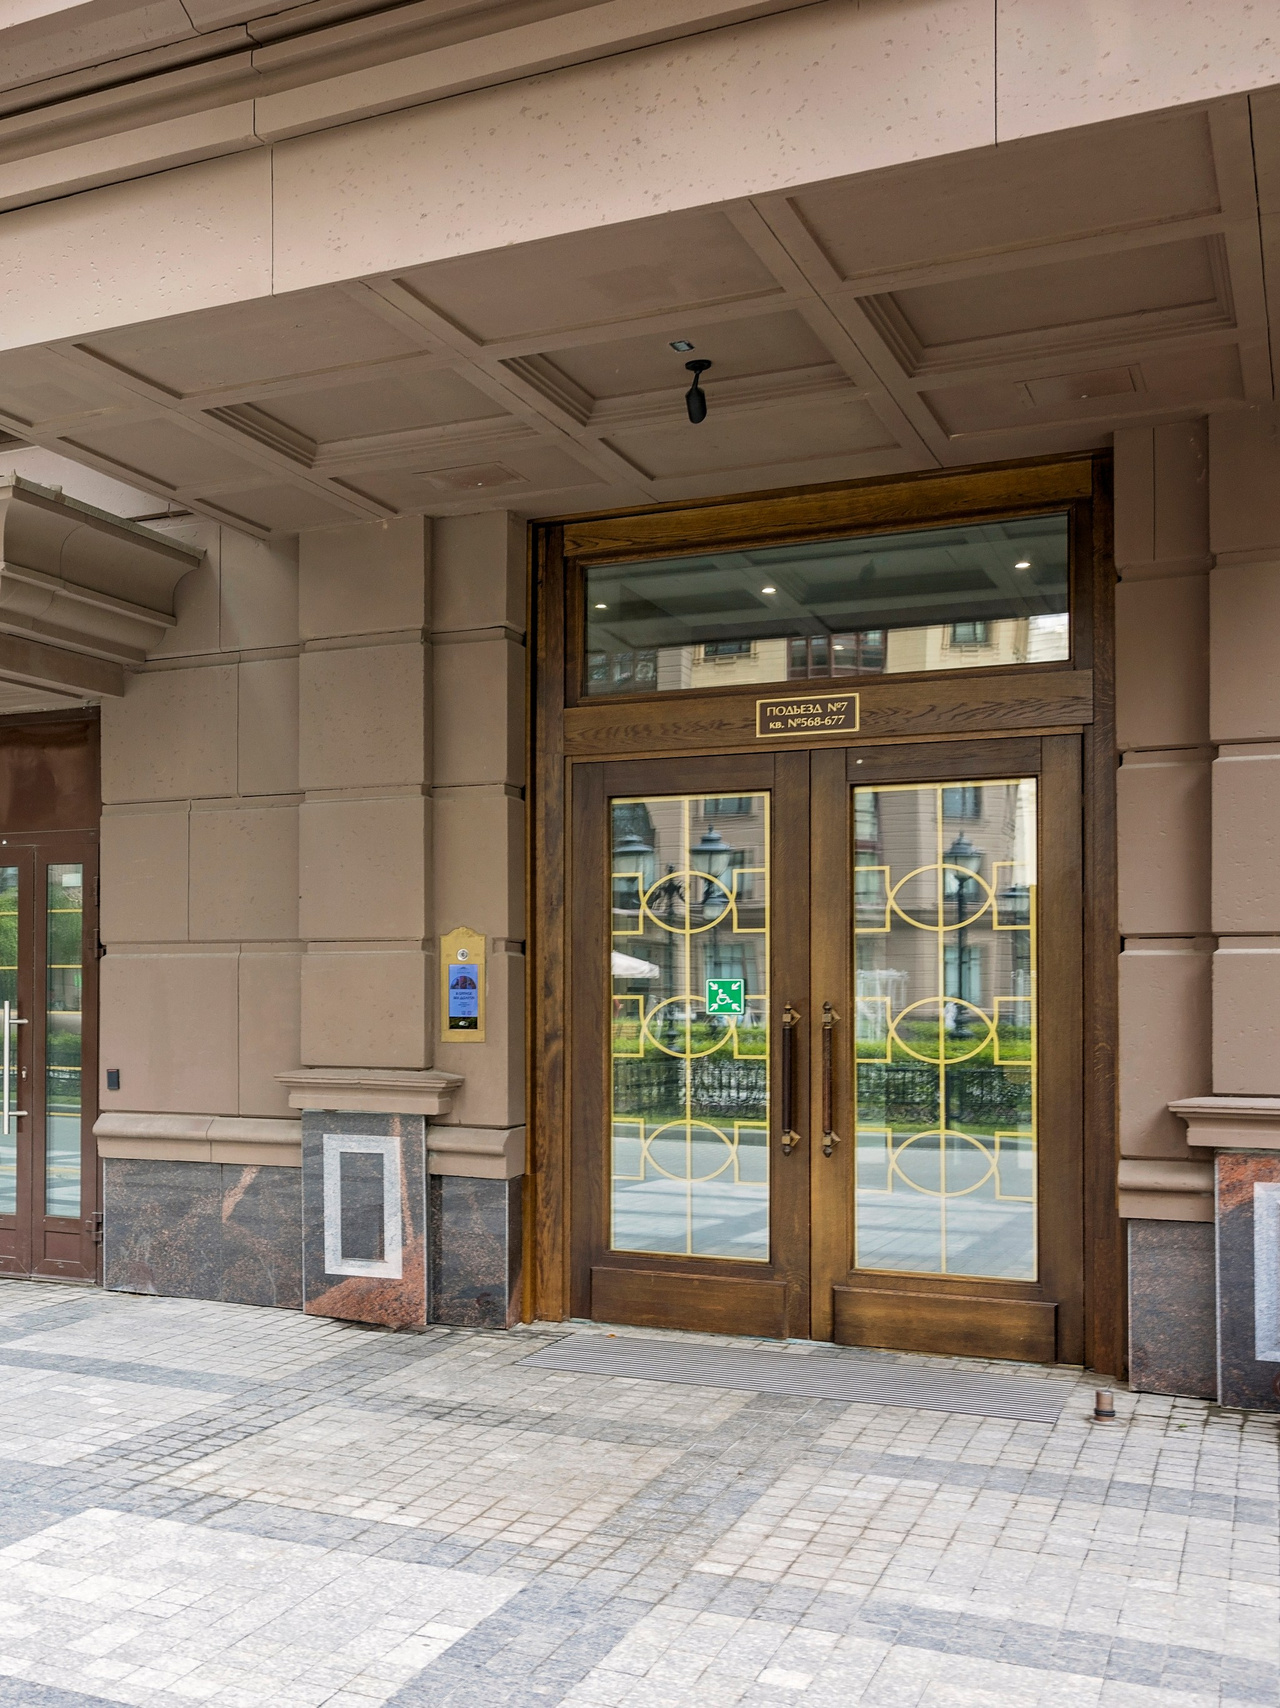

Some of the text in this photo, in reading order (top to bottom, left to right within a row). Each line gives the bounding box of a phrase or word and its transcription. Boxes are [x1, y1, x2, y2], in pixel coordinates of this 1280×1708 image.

[766, 702, 848, 716] ПОДЪЕЗД №7
[769, 715, 845, 729] кв. №568-677
